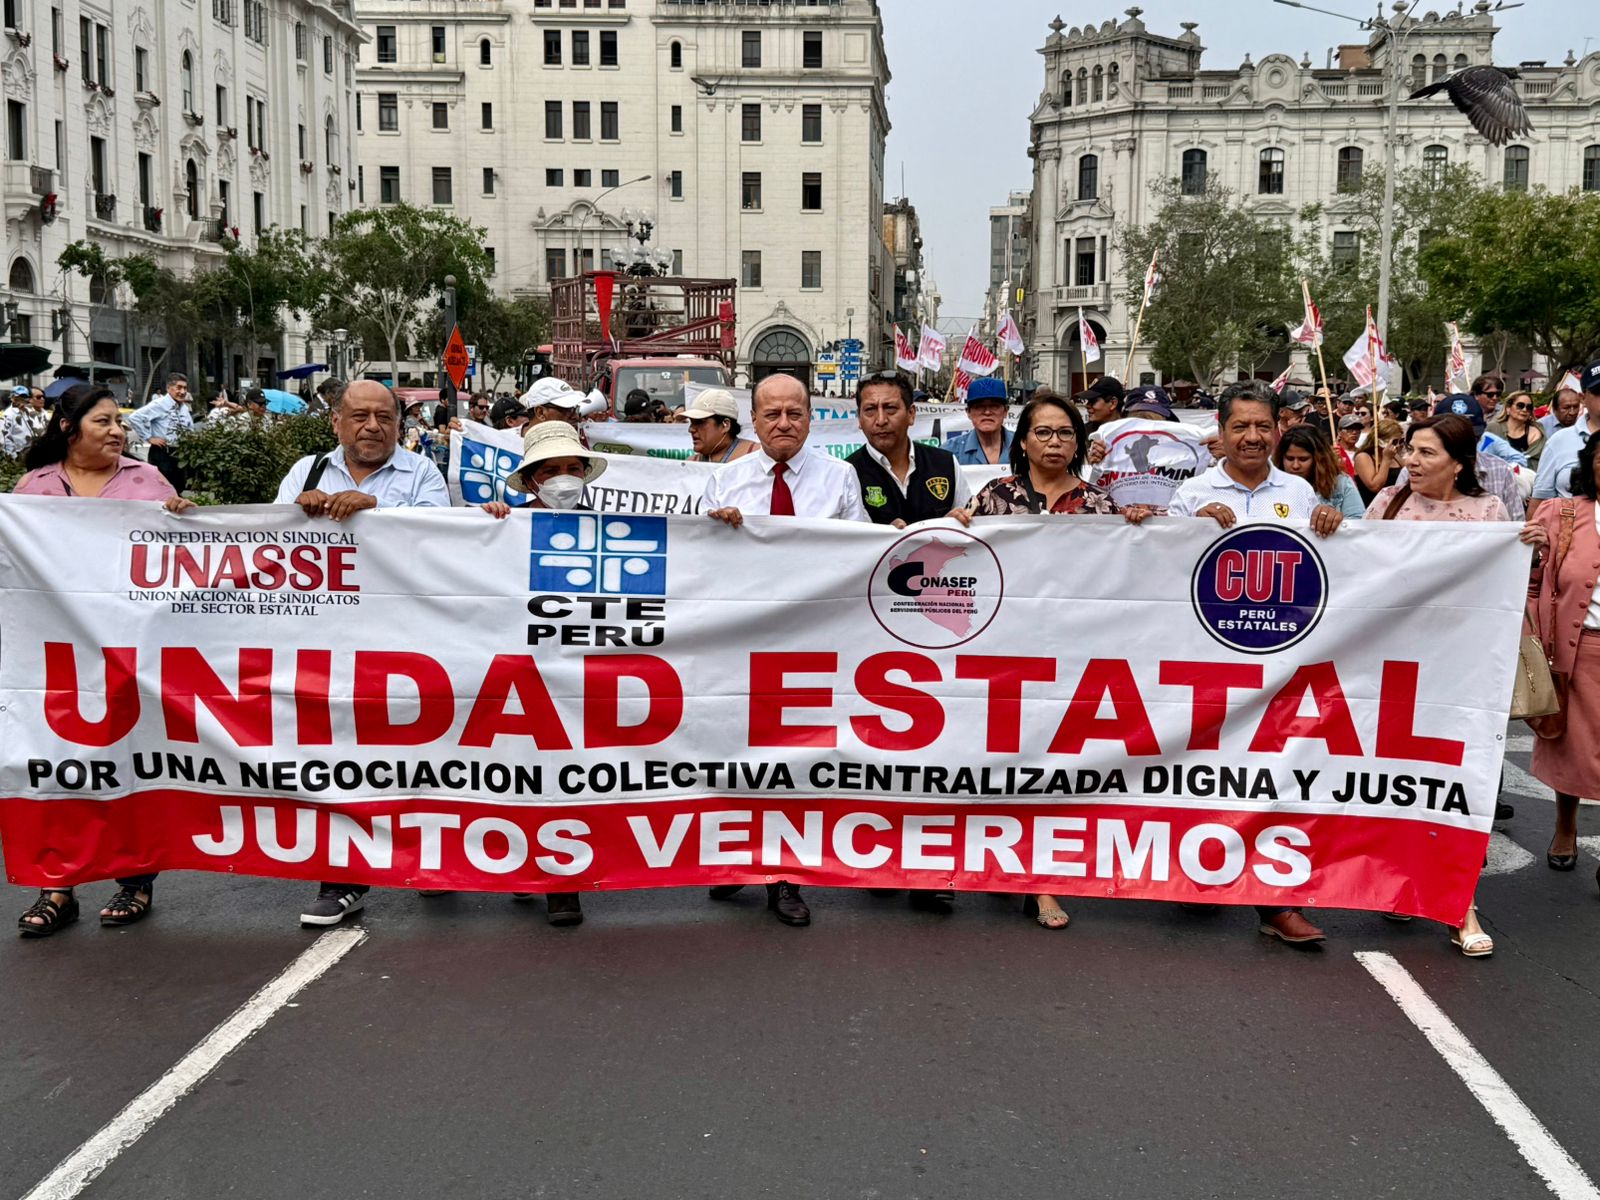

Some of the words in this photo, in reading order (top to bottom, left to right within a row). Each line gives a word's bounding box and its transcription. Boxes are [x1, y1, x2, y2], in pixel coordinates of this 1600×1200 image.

[129, 530, 279, 543] CONFEDERACION
[282, 531, 360, 546] SINDICAL
[130, 544, 360, 592] UNASSE
[887, 561, 977, 597] CONASEP
[1215, 549, 1302, 603] CUT
[129, 591, 177, 601] UNION
[179, 591, 256, 603] NACIONAL
[258, 592, 277, 603] DE
[279, 593, 360, 605] SINDICATOS
[947, 588, 976, 597] PERÚ
[171, 603, 199, 614] DEL
[201, 603, 257, 615] SECTOR
[259, 604, 319, 616] ESTATAL
[527, 595, 666, 620] CTE
[1239, 608, 1276, 620] PERÚ
[527, 622, 664, 647] PERÚ
[1217, 620, 1298, 632] ESTATALES
[45, 642, 683, 751] UNIDAD
[749, 652, 1465, 767] ESTATAL
[28, 758, 121, 790] POR
[133, 752, 226, 785] UNA
[239, 760, 542, 795] NEGOCIACION
[559, 761, 796, 795] COLECTIVA
[809, 762, 1129, 796] CENTRALIZADA
[1143, 764, 1279, 800] DIGNA
[1292, 769, 1321, 801] Y
[1332, 771, 1471, 816] JUSTA
[192, 805, 594, 876] JUNTOS
[626, 810, 1312, 887] VENCEREMOS
